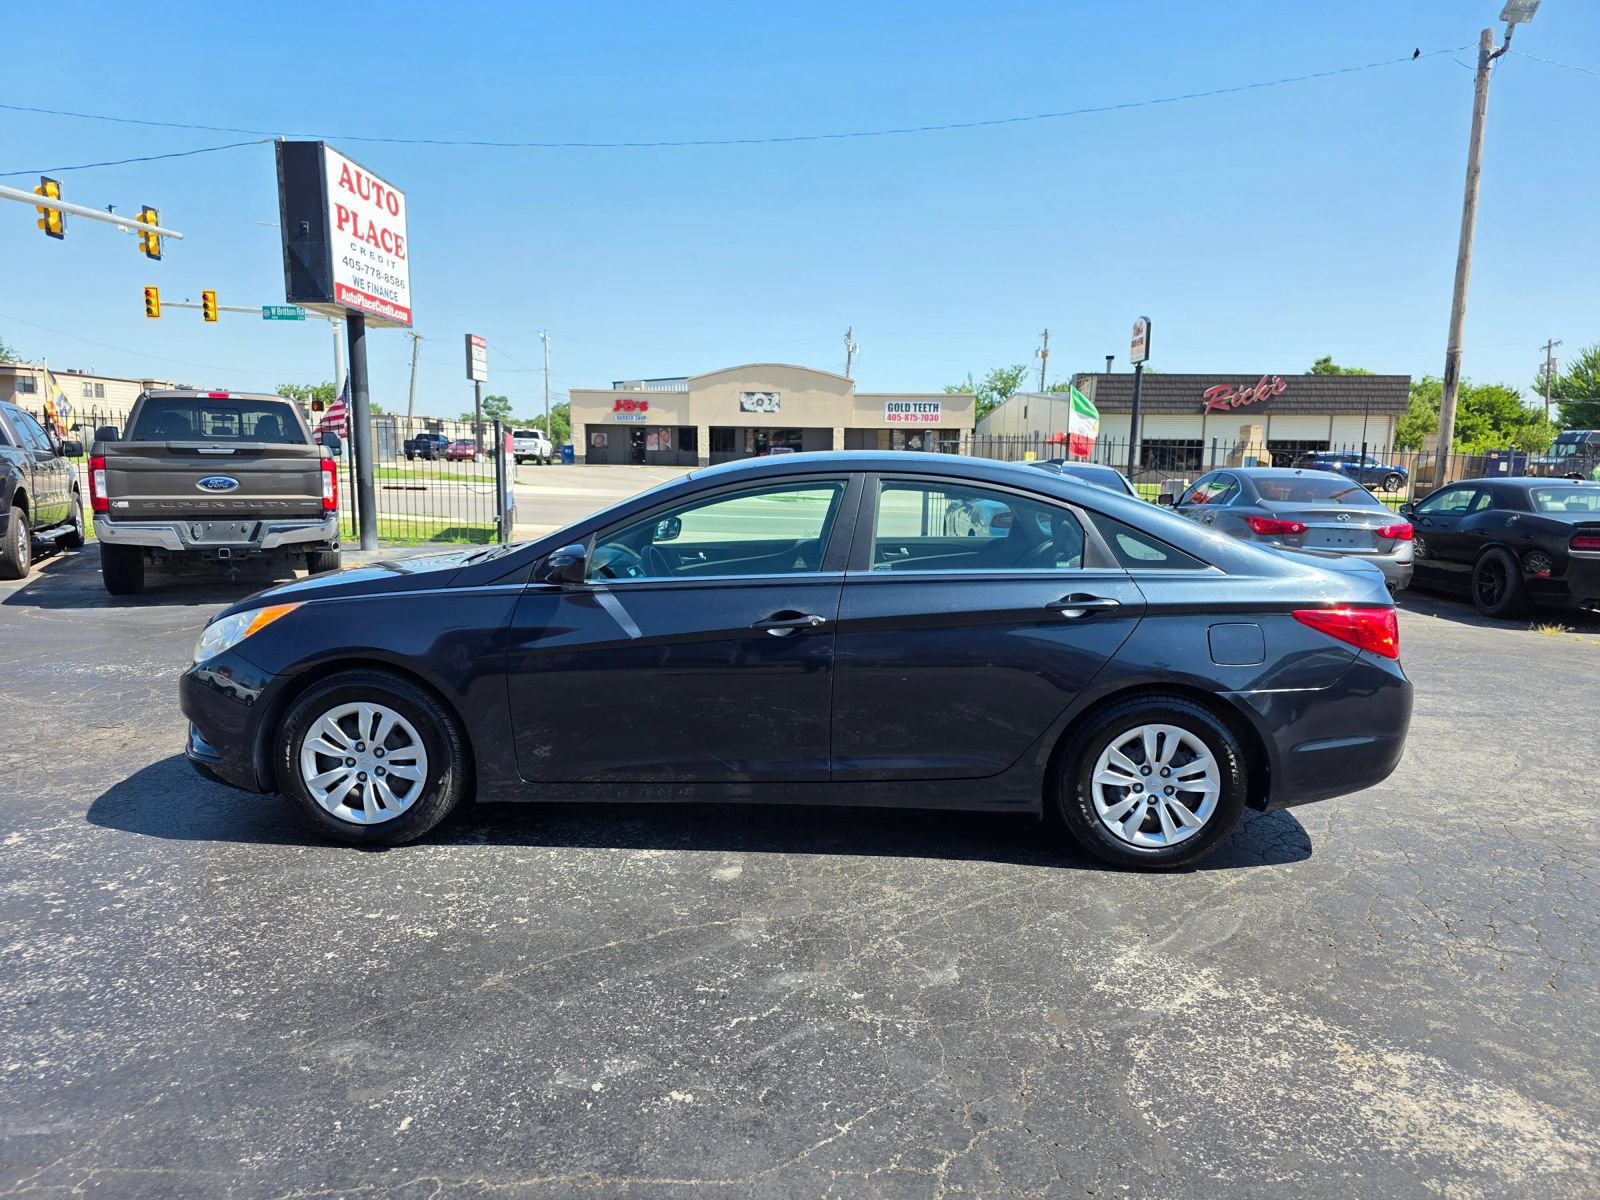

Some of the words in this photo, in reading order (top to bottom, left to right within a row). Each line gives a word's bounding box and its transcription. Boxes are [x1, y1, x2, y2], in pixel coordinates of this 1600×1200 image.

[338, 162, 399, 217] AUTO
[334, 202, 405, 260] PLACE
[350, 242, 396, 269] CREDIT
[342, 256, 406, 289] 405-778-8586
[352, 275, 365, 290] WE
[366, 281, 399, 302] FINANCE
[271, 307, 277, 316] W
[277, 306, 296, 316] Britton
[296, 307, 305, 316] Rd
[340, 288, 409, 321] AutoPlaceCredit.com
[887, 403, 911, 413] GOLD
[912, 403, 939, 413] TEETH
[1203, 374, 1287, 415] Rick's
[886, 413, 939, 422] 405-875-7030
